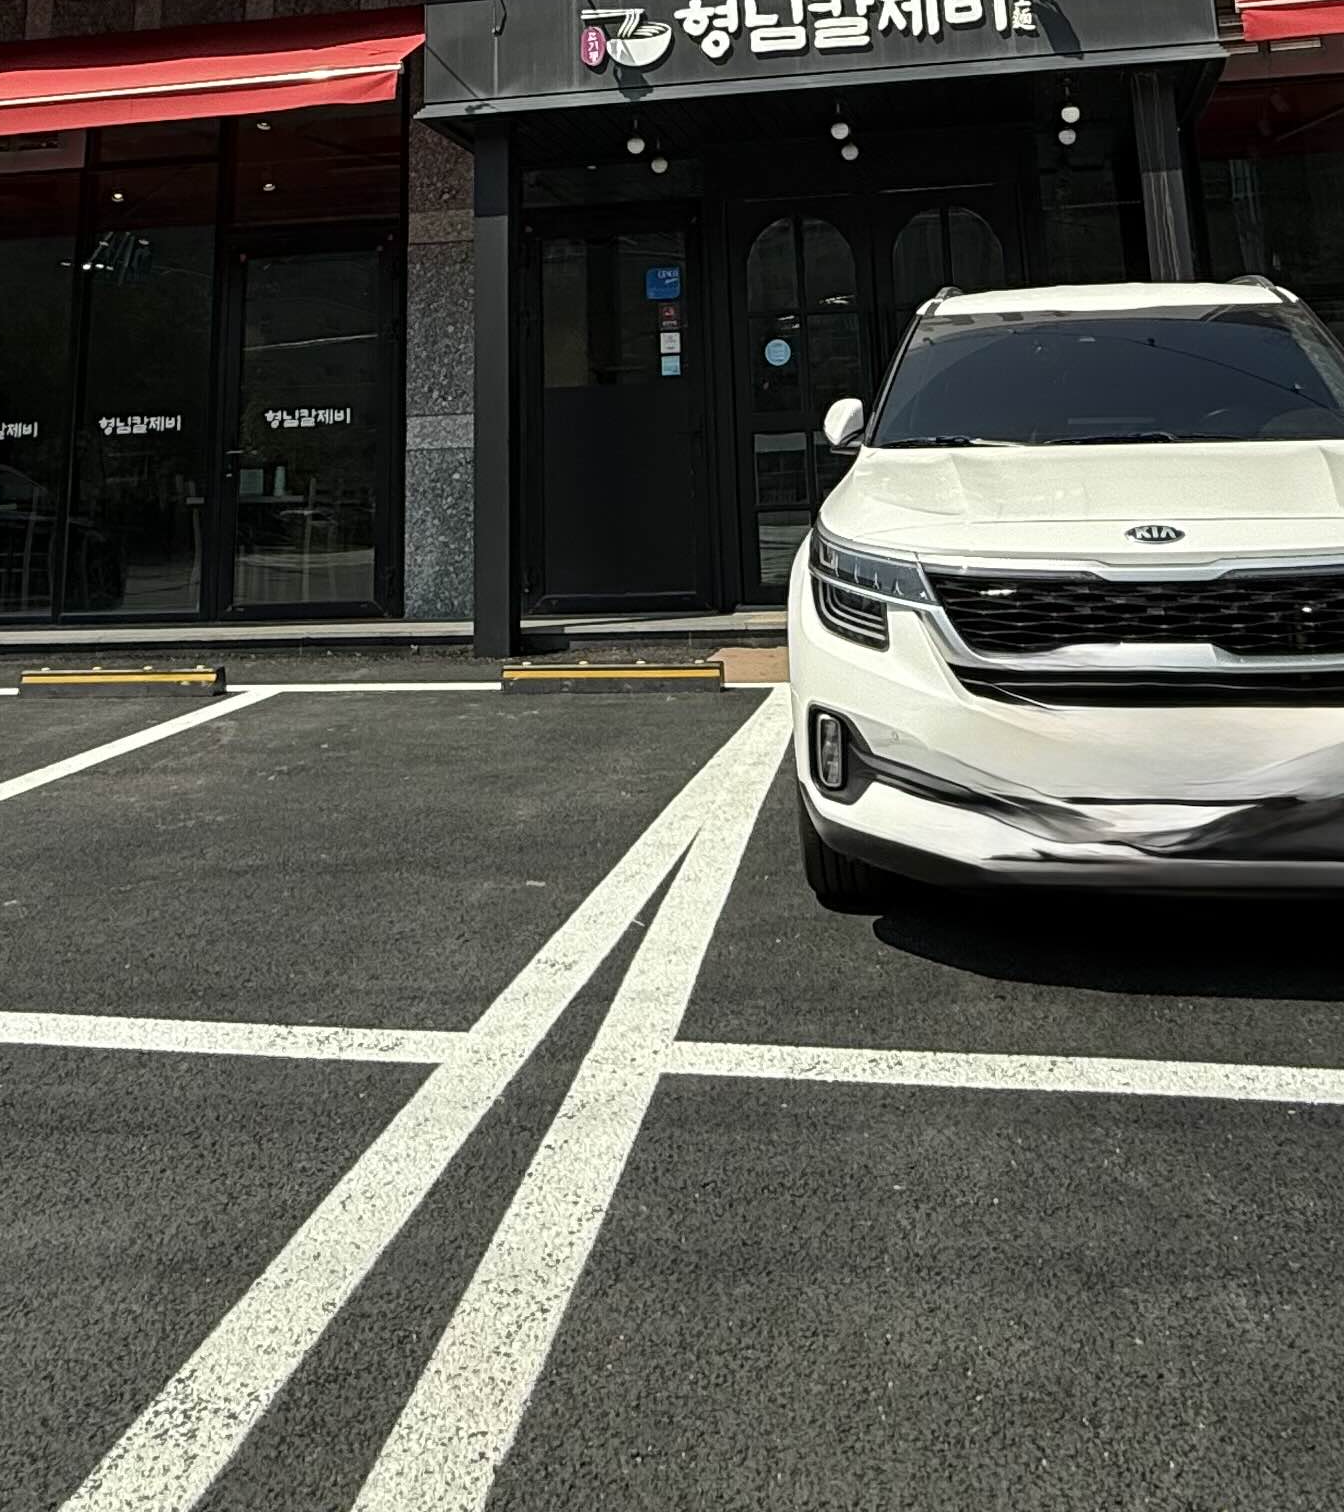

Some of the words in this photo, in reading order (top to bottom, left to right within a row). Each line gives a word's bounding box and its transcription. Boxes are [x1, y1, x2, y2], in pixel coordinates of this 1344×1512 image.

[98, 415, 183, 436] 형님칼제비
[264, 407, 352, 429] 형님칼제비
[1136, 526, 1177, 539] KIA
